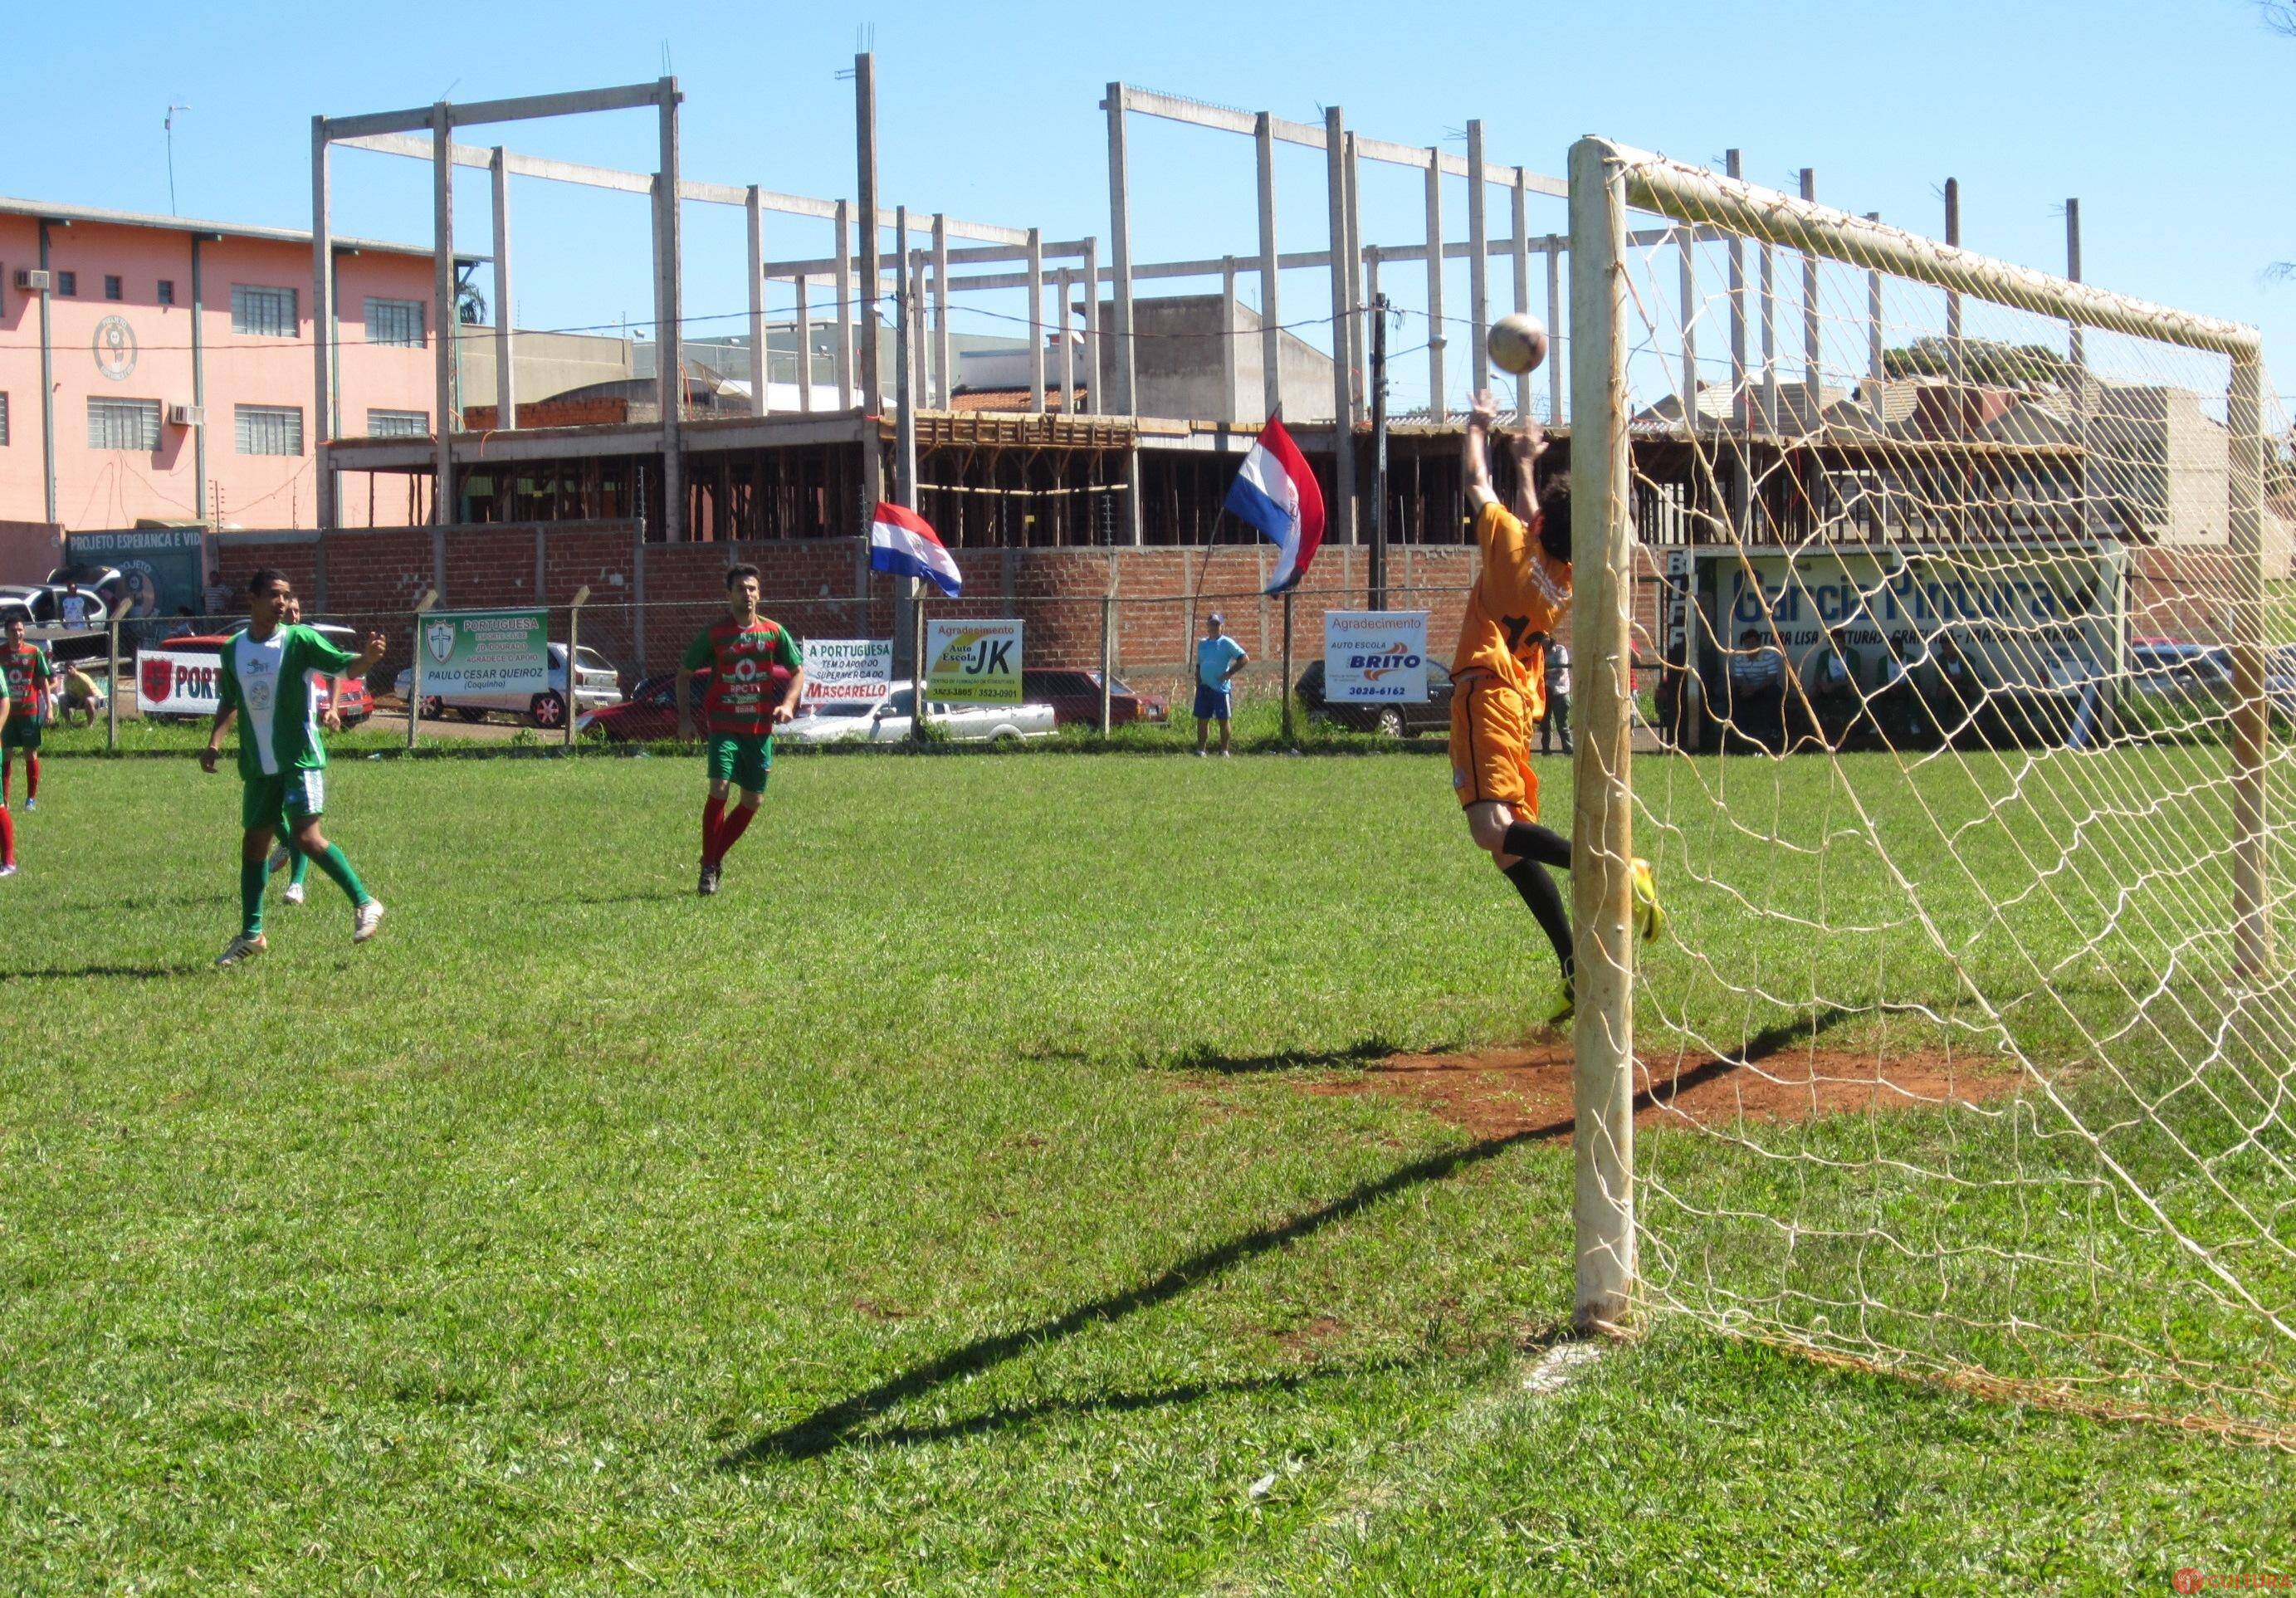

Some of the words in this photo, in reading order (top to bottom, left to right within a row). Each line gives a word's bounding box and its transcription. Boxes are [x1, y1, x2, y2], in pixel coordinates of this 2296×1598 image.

[71, 533, 114, 551] PROJETO
[175, 532, 180, 546] E
[183, 532, 202, 546] VID
[1734, 569, 1872, 622] Garcia
[1886, 566, 2054, 619] Pintura
[464, 618, 539, 631] PORTUGUESA
[938, 625, 1014, 637] Agradecimento
[1332, 618, 1421, 631] Agradecimento
[1795, 631, 1819, 645] LISA
[809, 645, 818, 657] A
[820, 644, 890, 657] PORTUGUESA
[950, 644, 972, 652] Auto
[467, 655, 506, 663] AGRADECE
[822, 659, 838, 668] TEM
[846, 660, 867, 668] APOIO
[943, 653, 976, 662] Escola
[965, 640, 1014, 674] JK
[1350, 655, 1420, 668] BRITO
[428, 670, 461, 680] PAULO
[464, 669, 496, 679] CESAR
[499, 667, 544, 678] QUEIROZ
[817, 671, 884, 679] SUPERMERCADO
[464, 681, 506, 690] (Coquinho)
[807, 682, 887, 698] MASCARELLO
[979, 689, 1017, 697] 3523-0901
